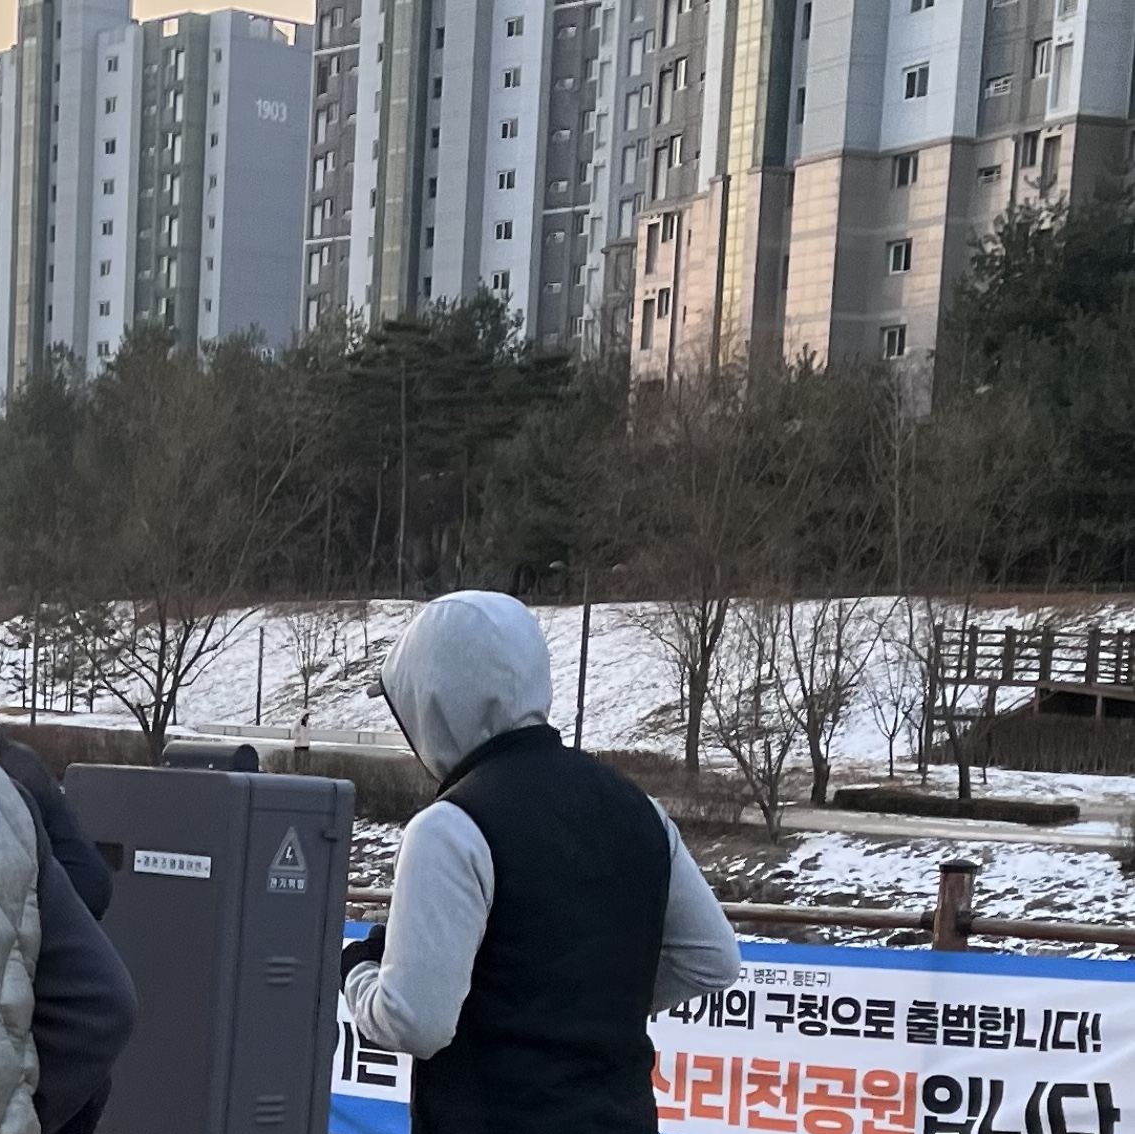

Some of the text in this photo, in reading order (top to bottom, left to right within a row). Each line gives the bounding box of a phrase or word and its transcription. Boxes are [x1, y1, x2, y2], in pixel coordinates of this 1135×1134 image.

[256, 98, 287, 123] 1903
[739, 968, 831, 987] 구, 병점구, 동탄구)
[765, 991, 896, 1039] 구청으로
[906, 999, 1102, 1053] 출범합니다!
